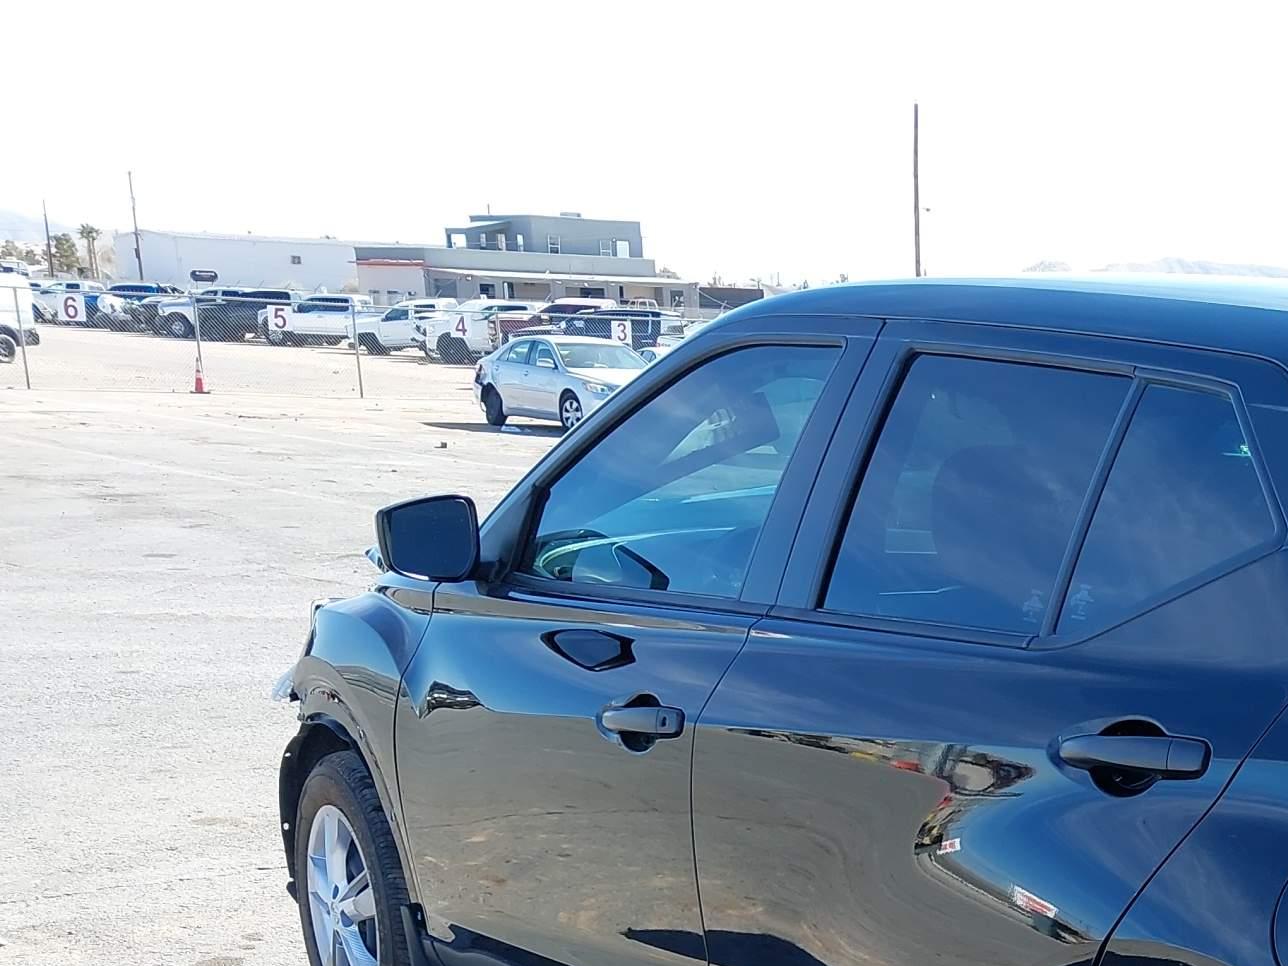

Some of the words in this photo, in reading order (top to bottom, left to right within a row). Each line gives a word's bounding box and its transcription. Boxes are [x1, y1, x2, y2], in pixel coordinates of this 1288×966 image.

[63, 296, 78, 319] 6
[273, 307, 287, 328] 5
[455, 315, 467, 336] 4
[616, 322, 628, 342] 3
